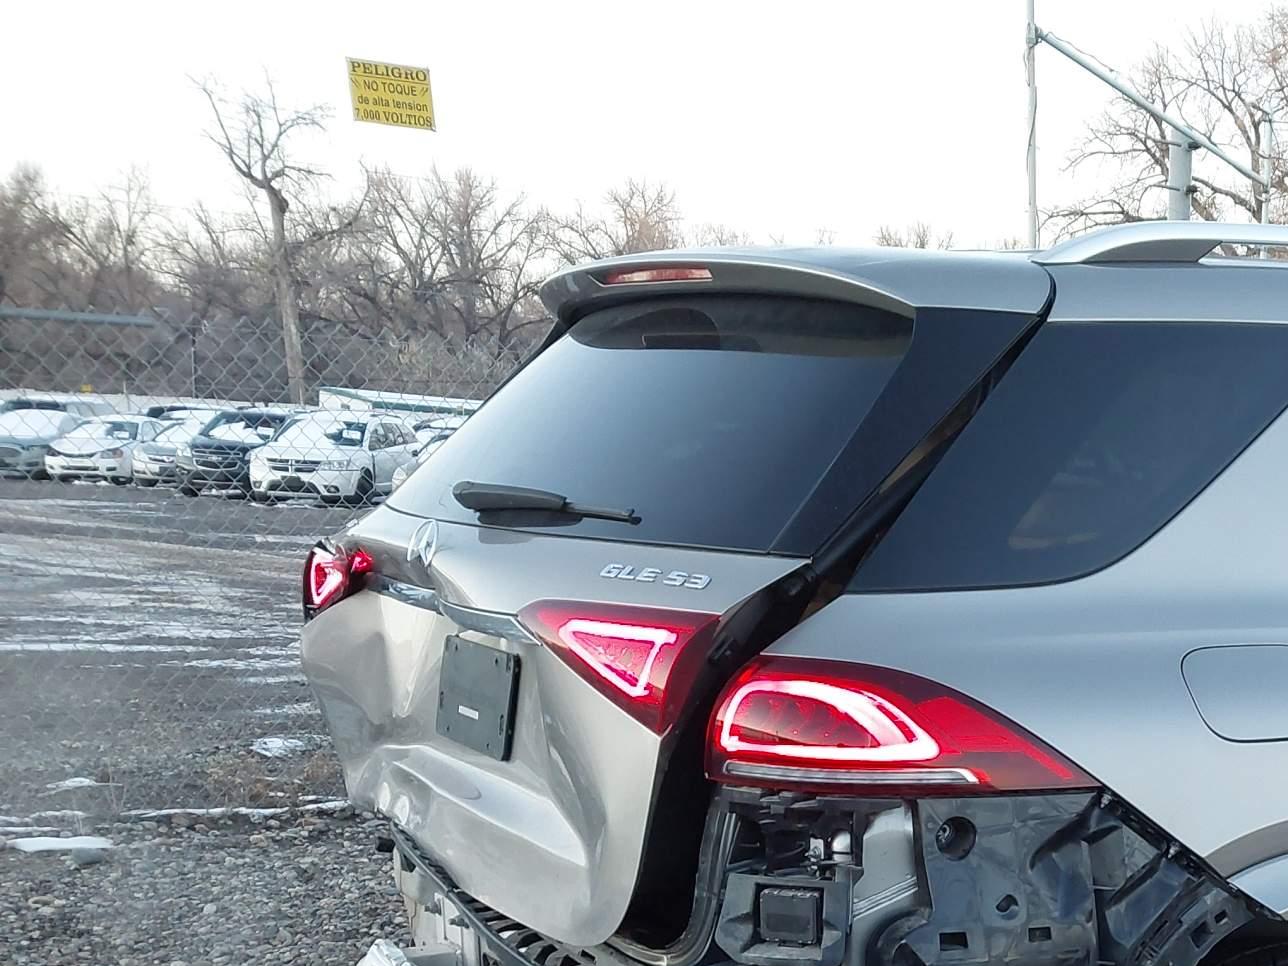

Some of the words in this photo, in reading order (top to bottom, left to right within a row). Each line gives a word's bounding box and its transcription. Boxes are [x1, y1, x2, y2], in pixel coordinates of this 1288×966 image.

[350, 61, 427, 82] PELIGRO
[363, 79, 379, 92] NO
[381, 81, 417, 97] TOQUE
[357, 94, 370, 105] de
[372, 96, 390, 108] alta
[392, 98, 429, 113] tension
[354, 107, 381, 121] 7,000
[383, 110, 433, 128] VOLTIOS
[600, 563, 663, 582] GLE
[663, 570, 712, 589] 53
